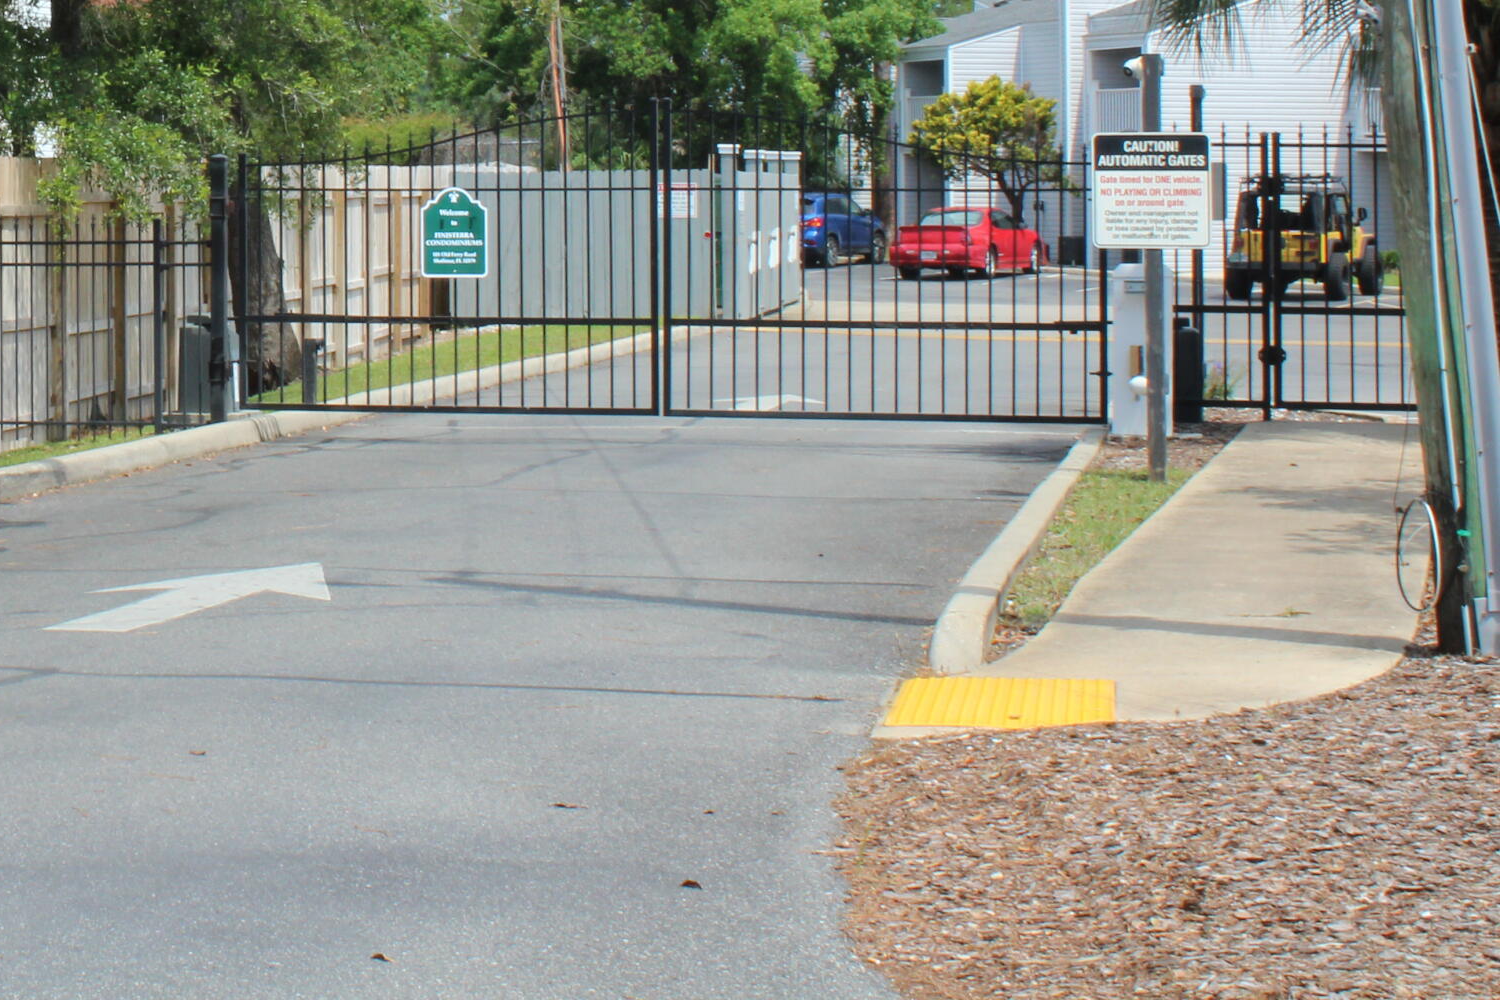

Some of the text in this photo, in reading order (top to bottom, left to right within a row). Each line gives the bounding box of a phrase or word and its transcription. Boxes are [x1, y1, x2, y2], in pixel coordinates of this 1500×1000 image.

[1123, 140, 1179, 153] CAUTION!
[1098, 154, 1205, 167] AUTOMATIC GATES
[1100, 176, 1117, 184] Gate
[1119, 176, 1141, 184] timed
[1143, 176, 1153, 184] for
[1155, 176, 1171, 184] ONE
[1100, 188, 1202, 197] NO PLAYING OR CLIMBING
[1137, 199, 1165, 207] around
